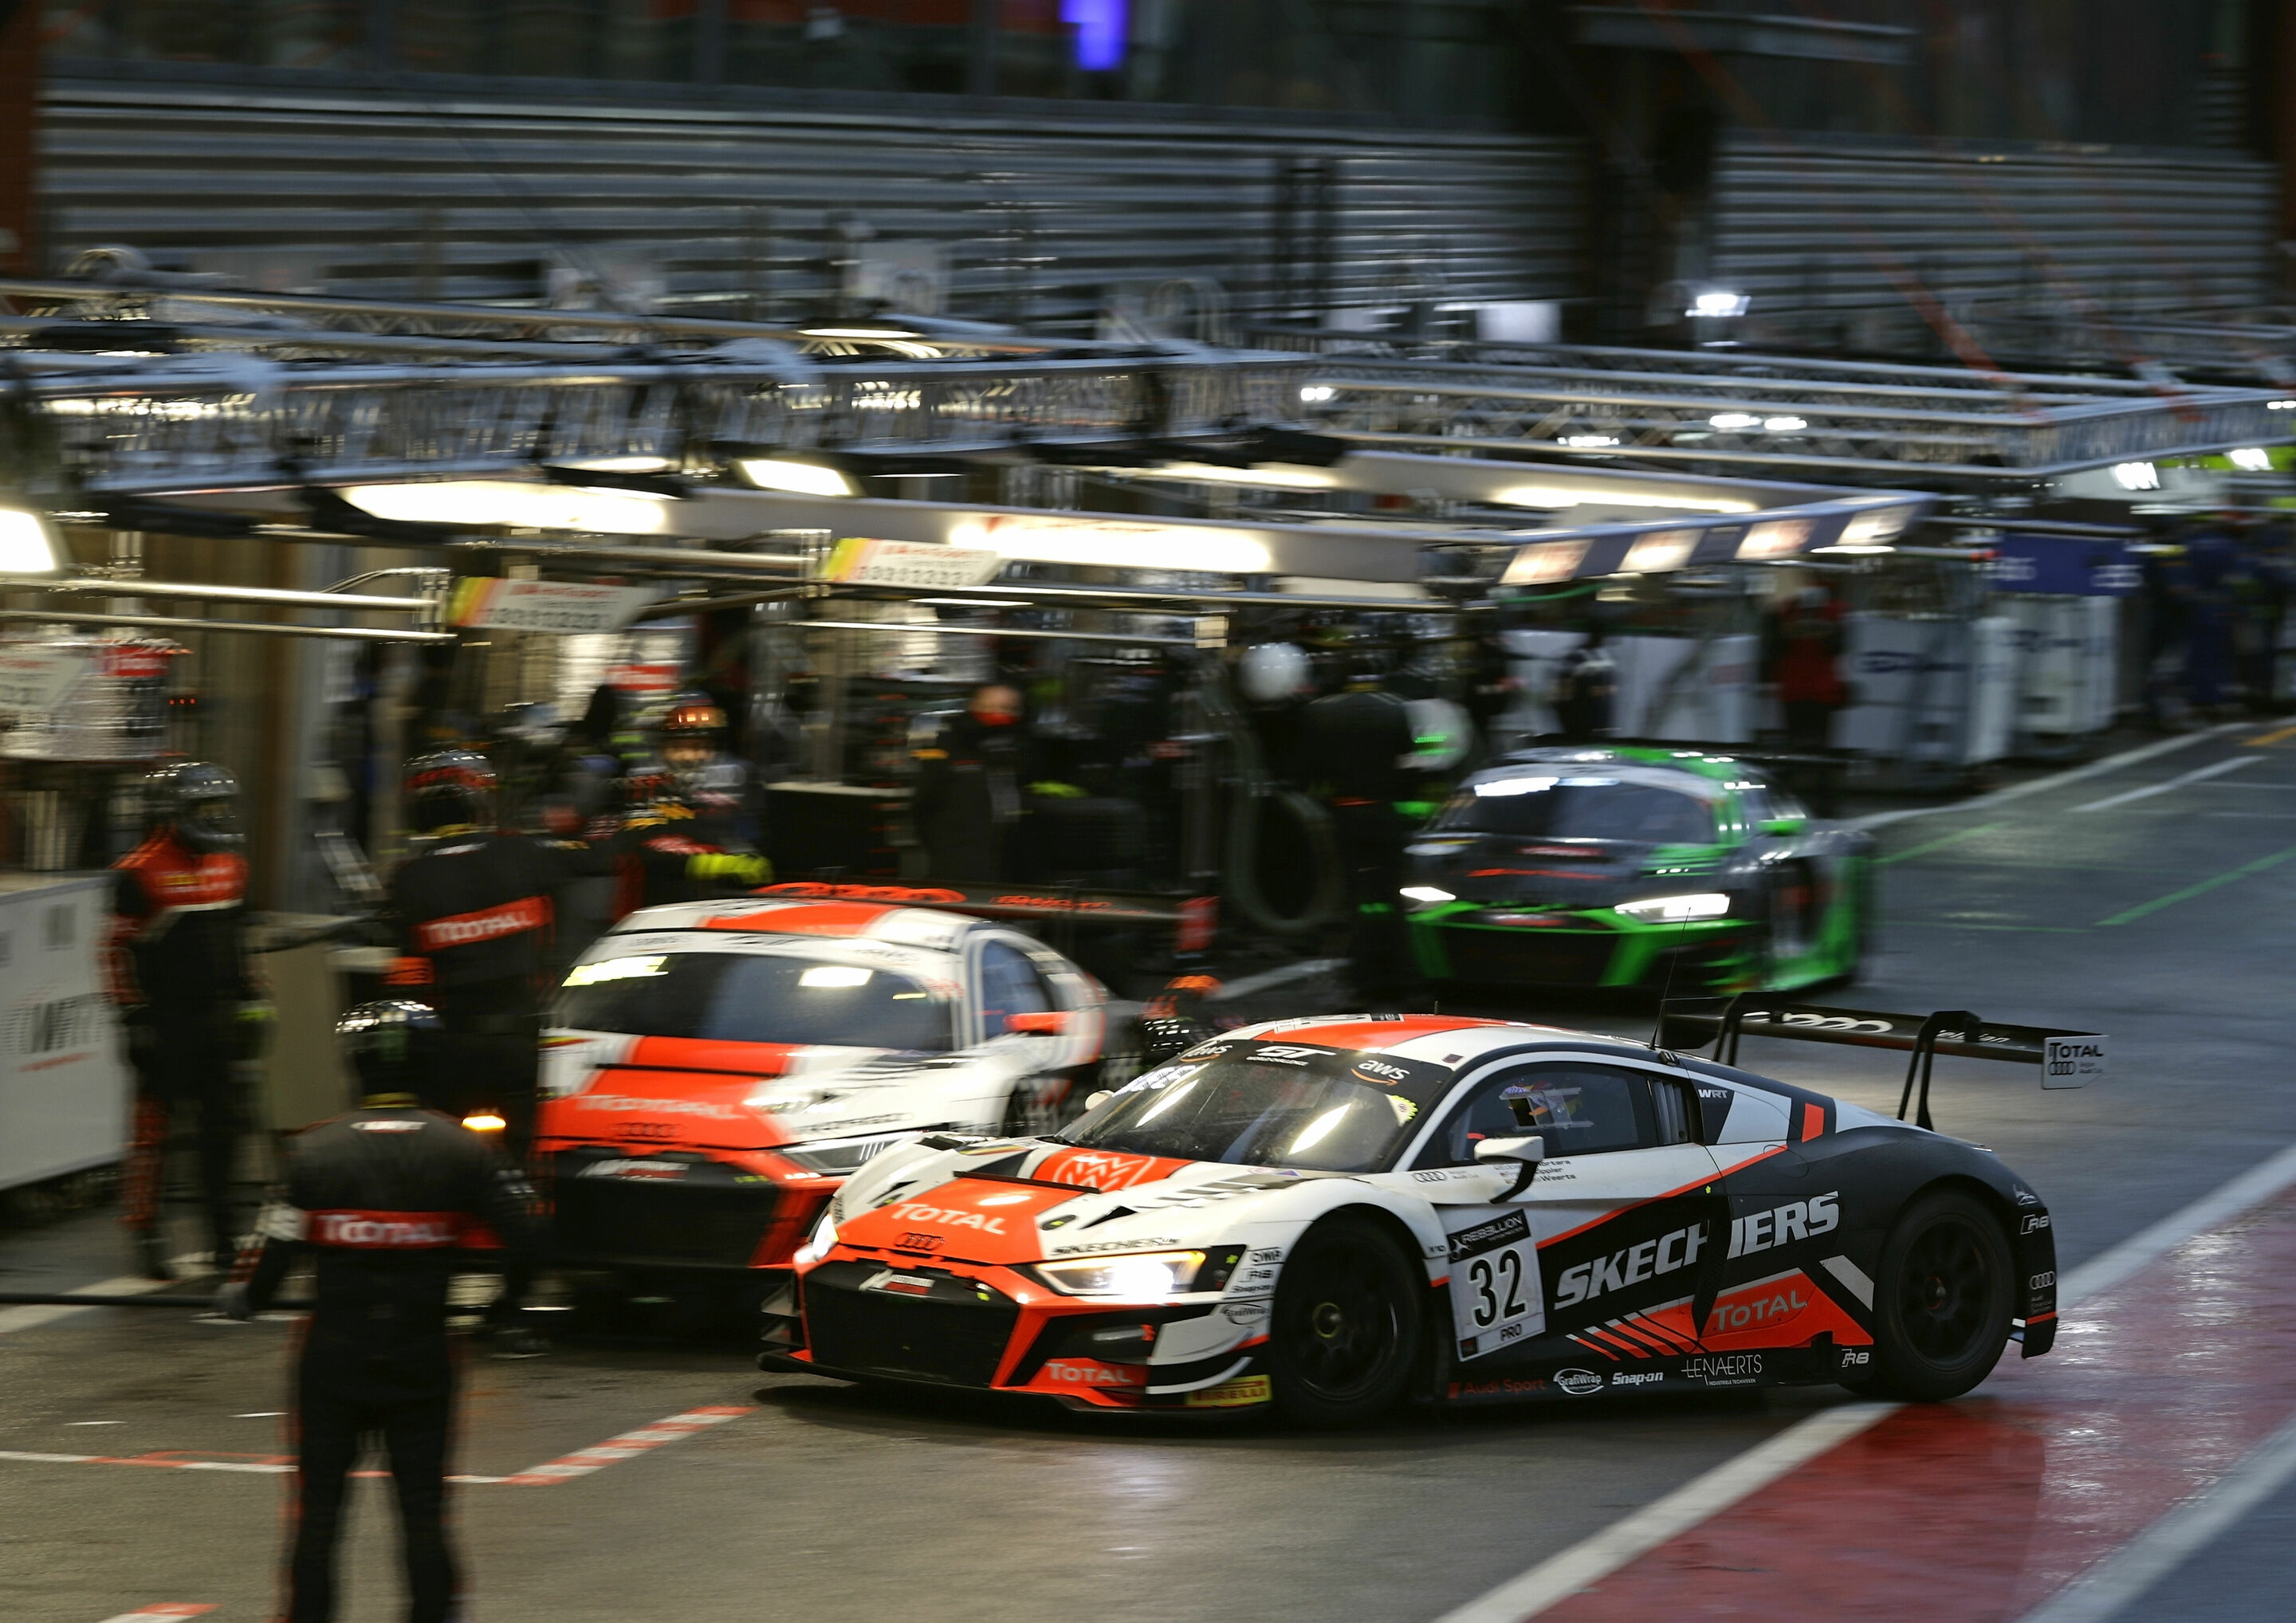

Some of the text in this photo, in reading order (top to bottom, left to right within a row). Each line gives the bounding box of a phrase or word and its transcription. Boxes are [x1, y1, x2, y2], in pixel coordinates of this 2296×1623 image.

[1255, 1045, 1337, 1059] GT
[2049, 1042, 2104, 1058] TOTAL
[1358, 1059, 1411, 1081] aws
[1697, 1089, 1728, 1098] WRT
[891, 1203, 1006, 1236] TOTAL
[1461, 1216, 1523, 1244] REBELLION
[1468, 1248, 1527, 1328] 32
[1713, 1290, 1808, 1331] TOTAL
[1500, 1323, 1523, 1341] PRO
[1044, 1362, 1133, 1383] TOTAL
[1611, 1371, 1664, 1385] Snap-on
[1681, 1354, 1763, 1385] LENAERTS
[1464, 1377, 1547, 1394] Audi Sport
[1558, 1373, 1602, 1386] GrafiWrap
